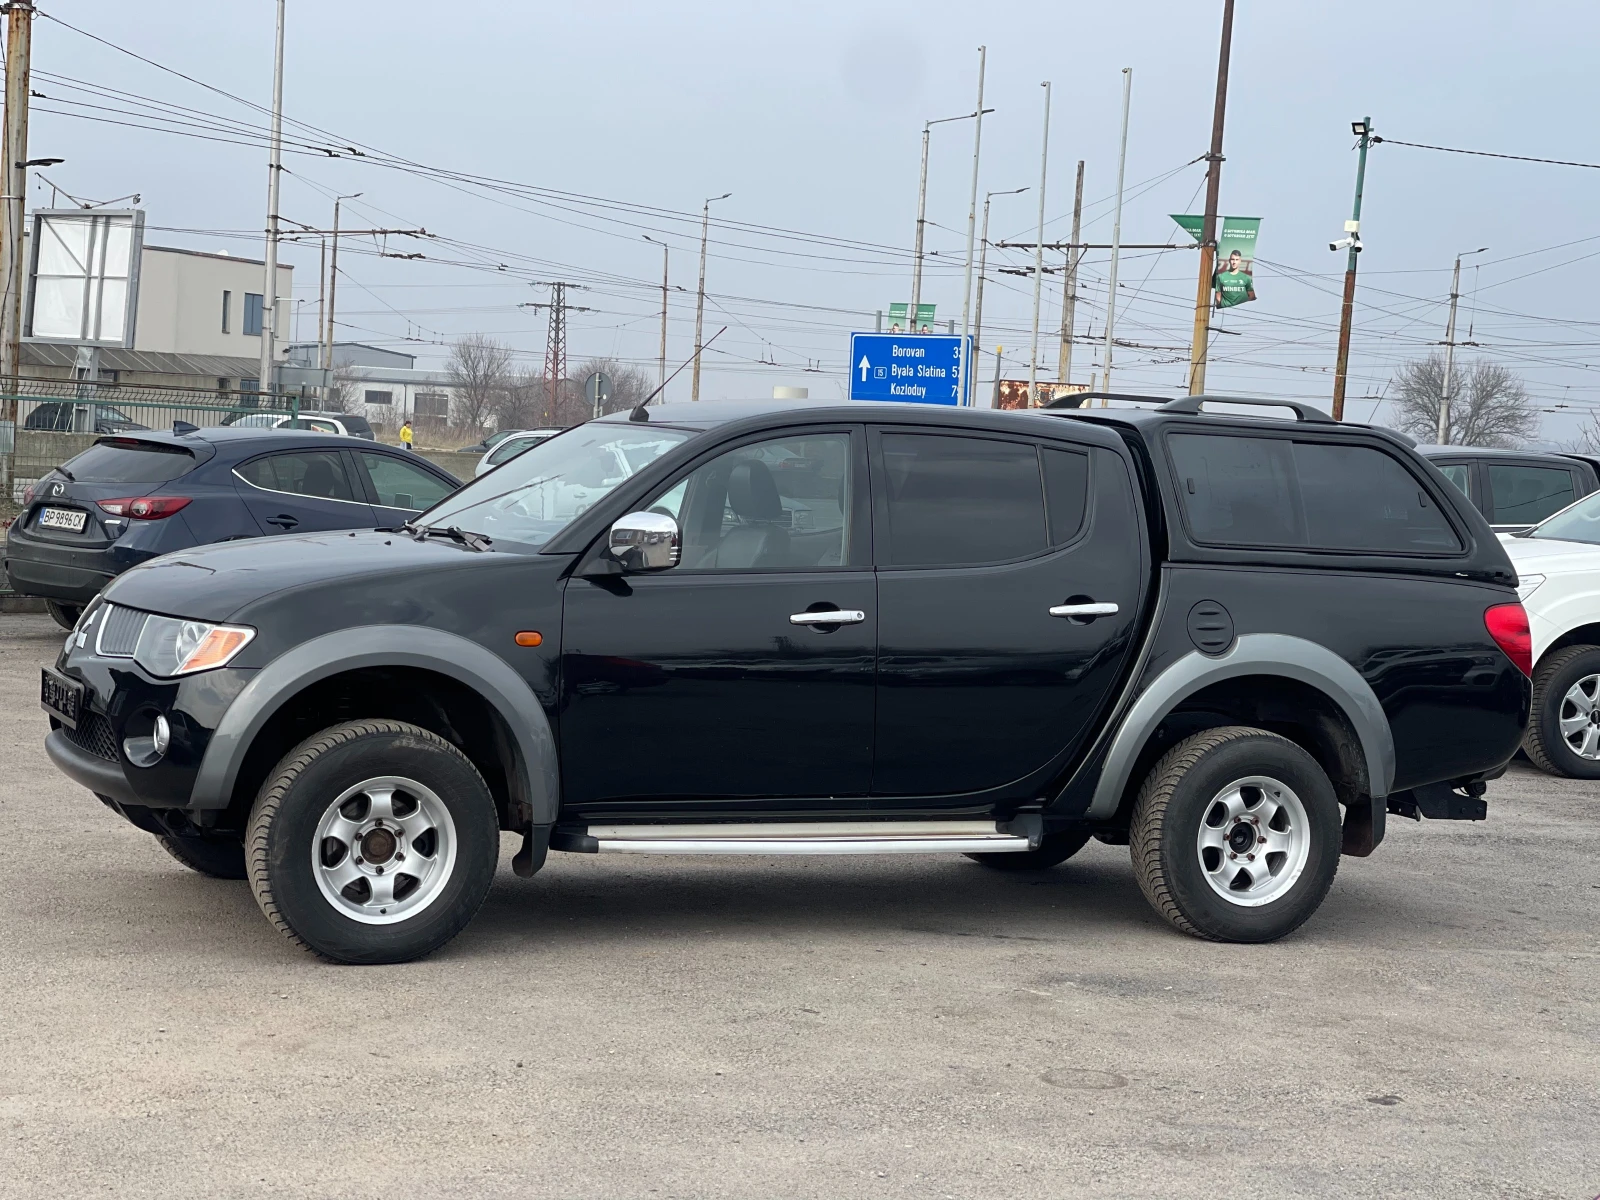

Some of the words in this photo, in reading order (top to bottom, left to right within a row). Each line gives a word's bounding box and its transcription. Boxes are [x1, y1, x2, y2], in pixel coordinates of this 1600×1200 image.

[892, 345, 925, 357] Borovan
[877, 369, 884, 377] 15
[891, 364, 914, 379] Byala
[917, 365, 946, 378] Slatina
[890, 383, 927, 398] Kozloduy
[44, 511, 55, 523] BP
[55, 512, 73, 526] 9896
[73, 514, 84, 527] CK
